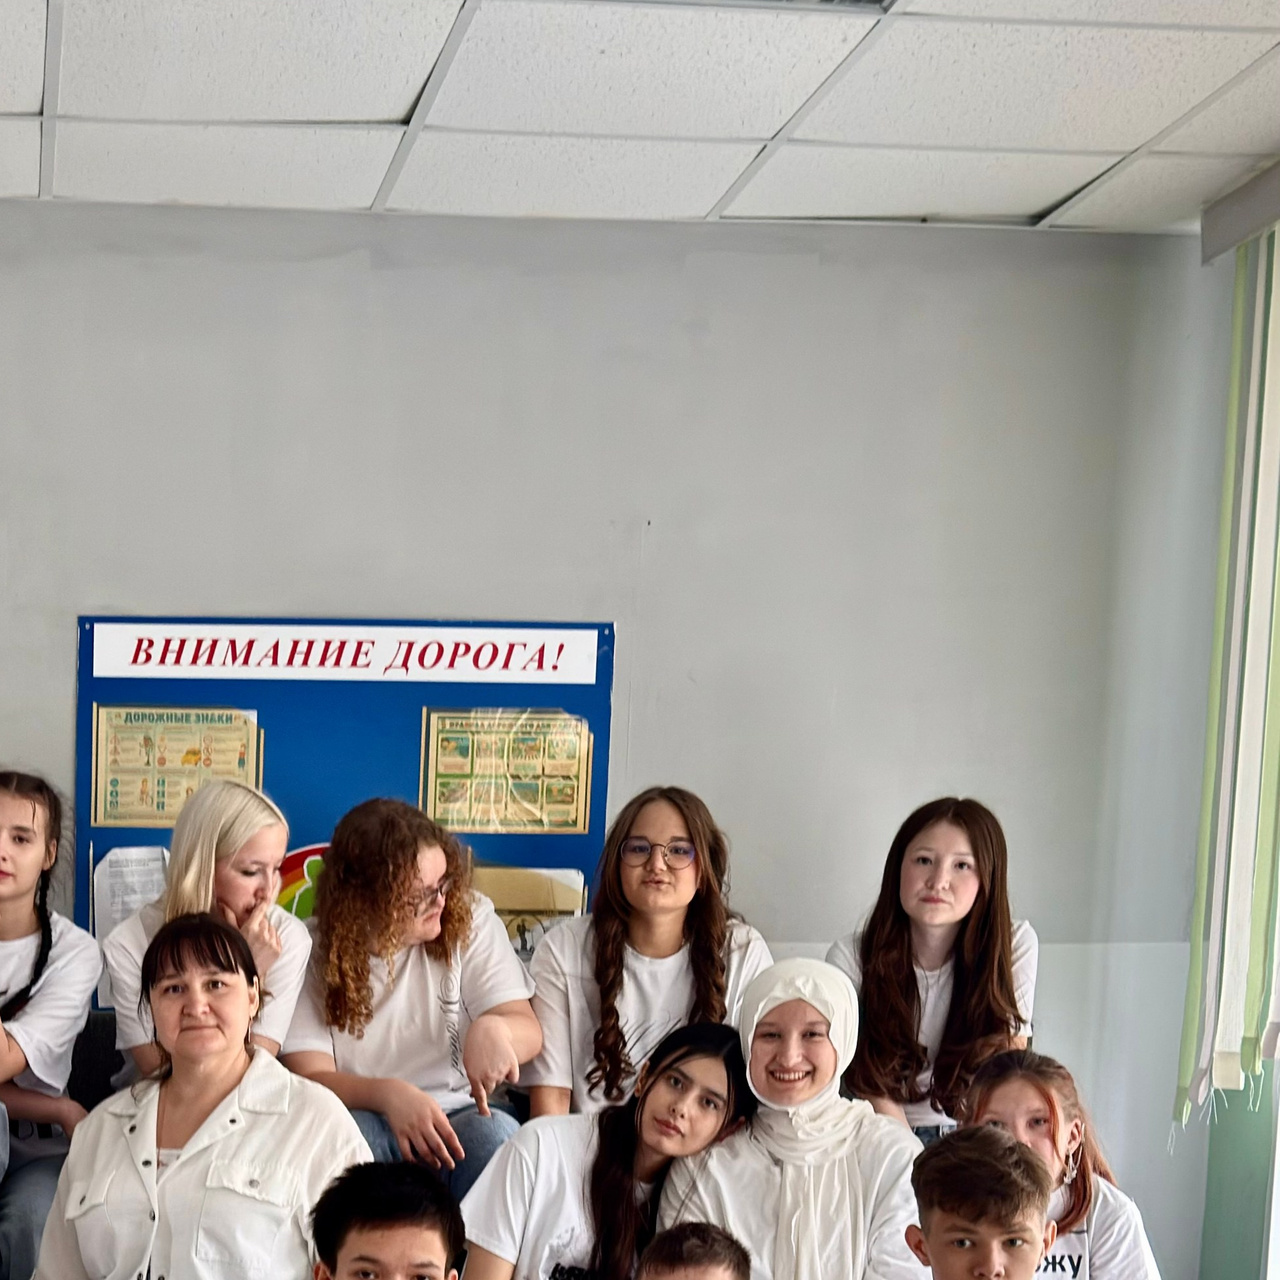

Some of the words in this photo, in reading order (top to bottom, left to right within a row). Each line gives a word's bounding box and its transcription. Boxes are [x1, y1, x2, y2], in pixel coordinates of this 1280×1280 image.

[129, 636, 376, 669] ВНИМАНИЕ
[382, 641, 566, 676] ДОРОГА!
[123, 711, 192, 725] ДОРОЖНЫЕ
[195, 712, 233, 725] ЗНАКИ
[1034, 1253, 1083, 1280] жу
